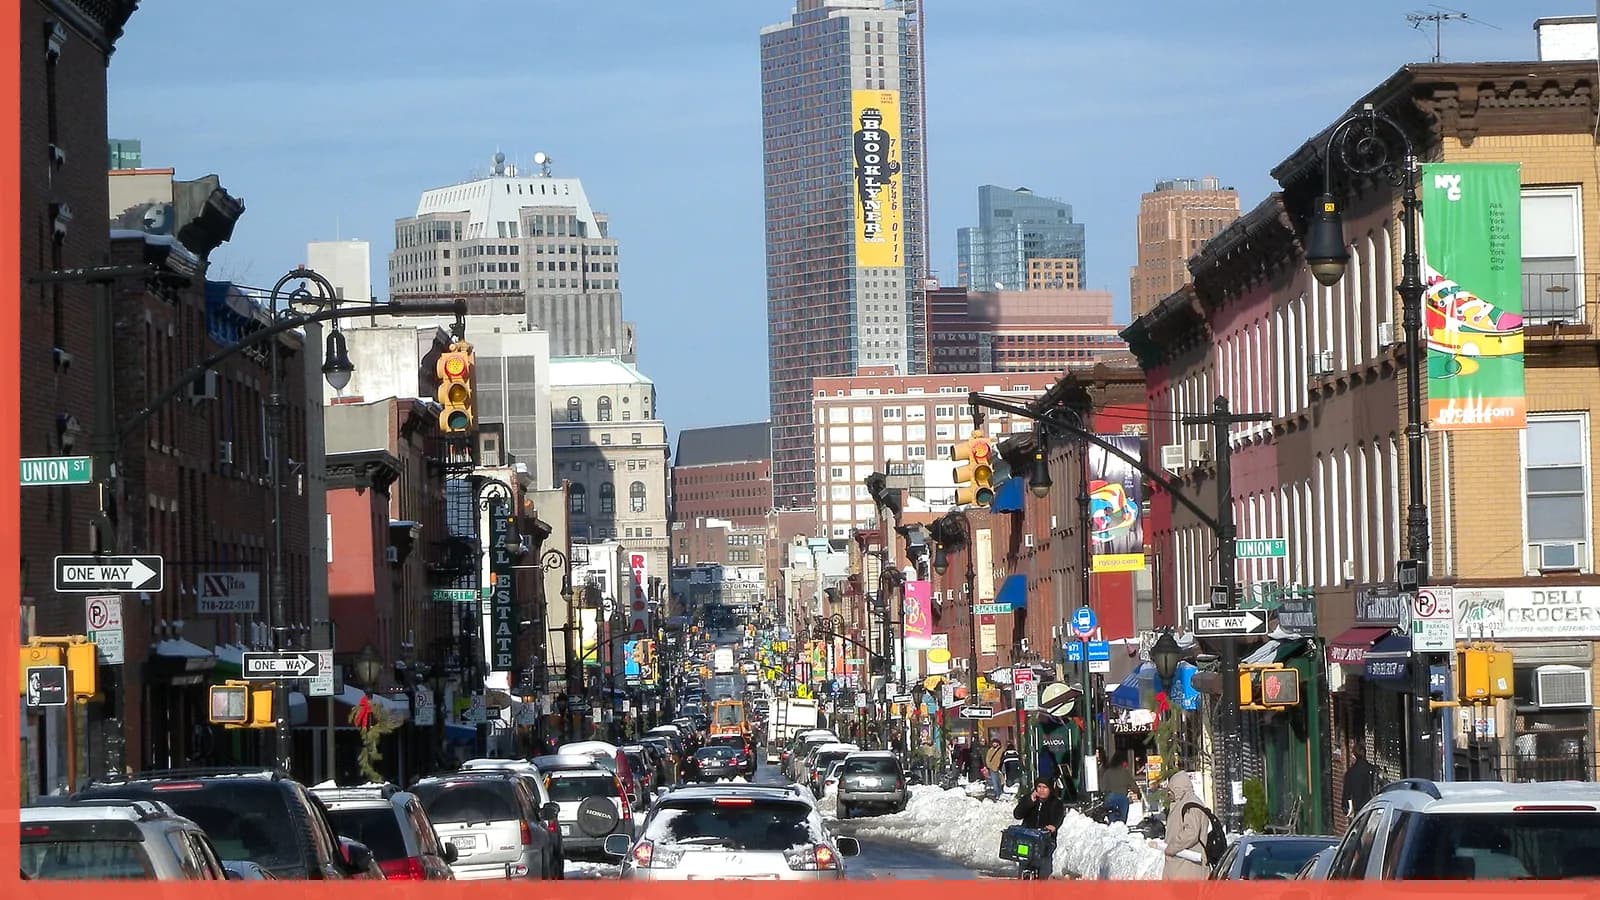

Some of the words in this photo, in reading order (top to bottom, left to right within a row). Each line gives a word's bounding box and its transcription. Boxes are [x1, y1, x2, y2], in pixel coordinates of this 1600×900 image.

[23, 461, 69, 482] UNION
[74, 460, 86, 471] ST
[494, 504, 510, 564] REAL
[1240, 541, 1272, 556] UNION
[1275, 541, 1284, 549] ST
[67, 567, 95, 580] ONE
[101, 567, 130, 580] WAY
[433, 591, 465, 600] SACKETT
[1531, 590, 1582, 605] DELI
[976, 605, 1003, 613] SACKETT
[496, 575, 512, 668] ESTATE
[1201, 619, 1220, 628] ONE
[1224, 618, 1244, 628] WAY
[254, 660, 276, 670] ONE
[286, 660, 307, 670] WAY
[586, 809, 612, 820] HONDA
